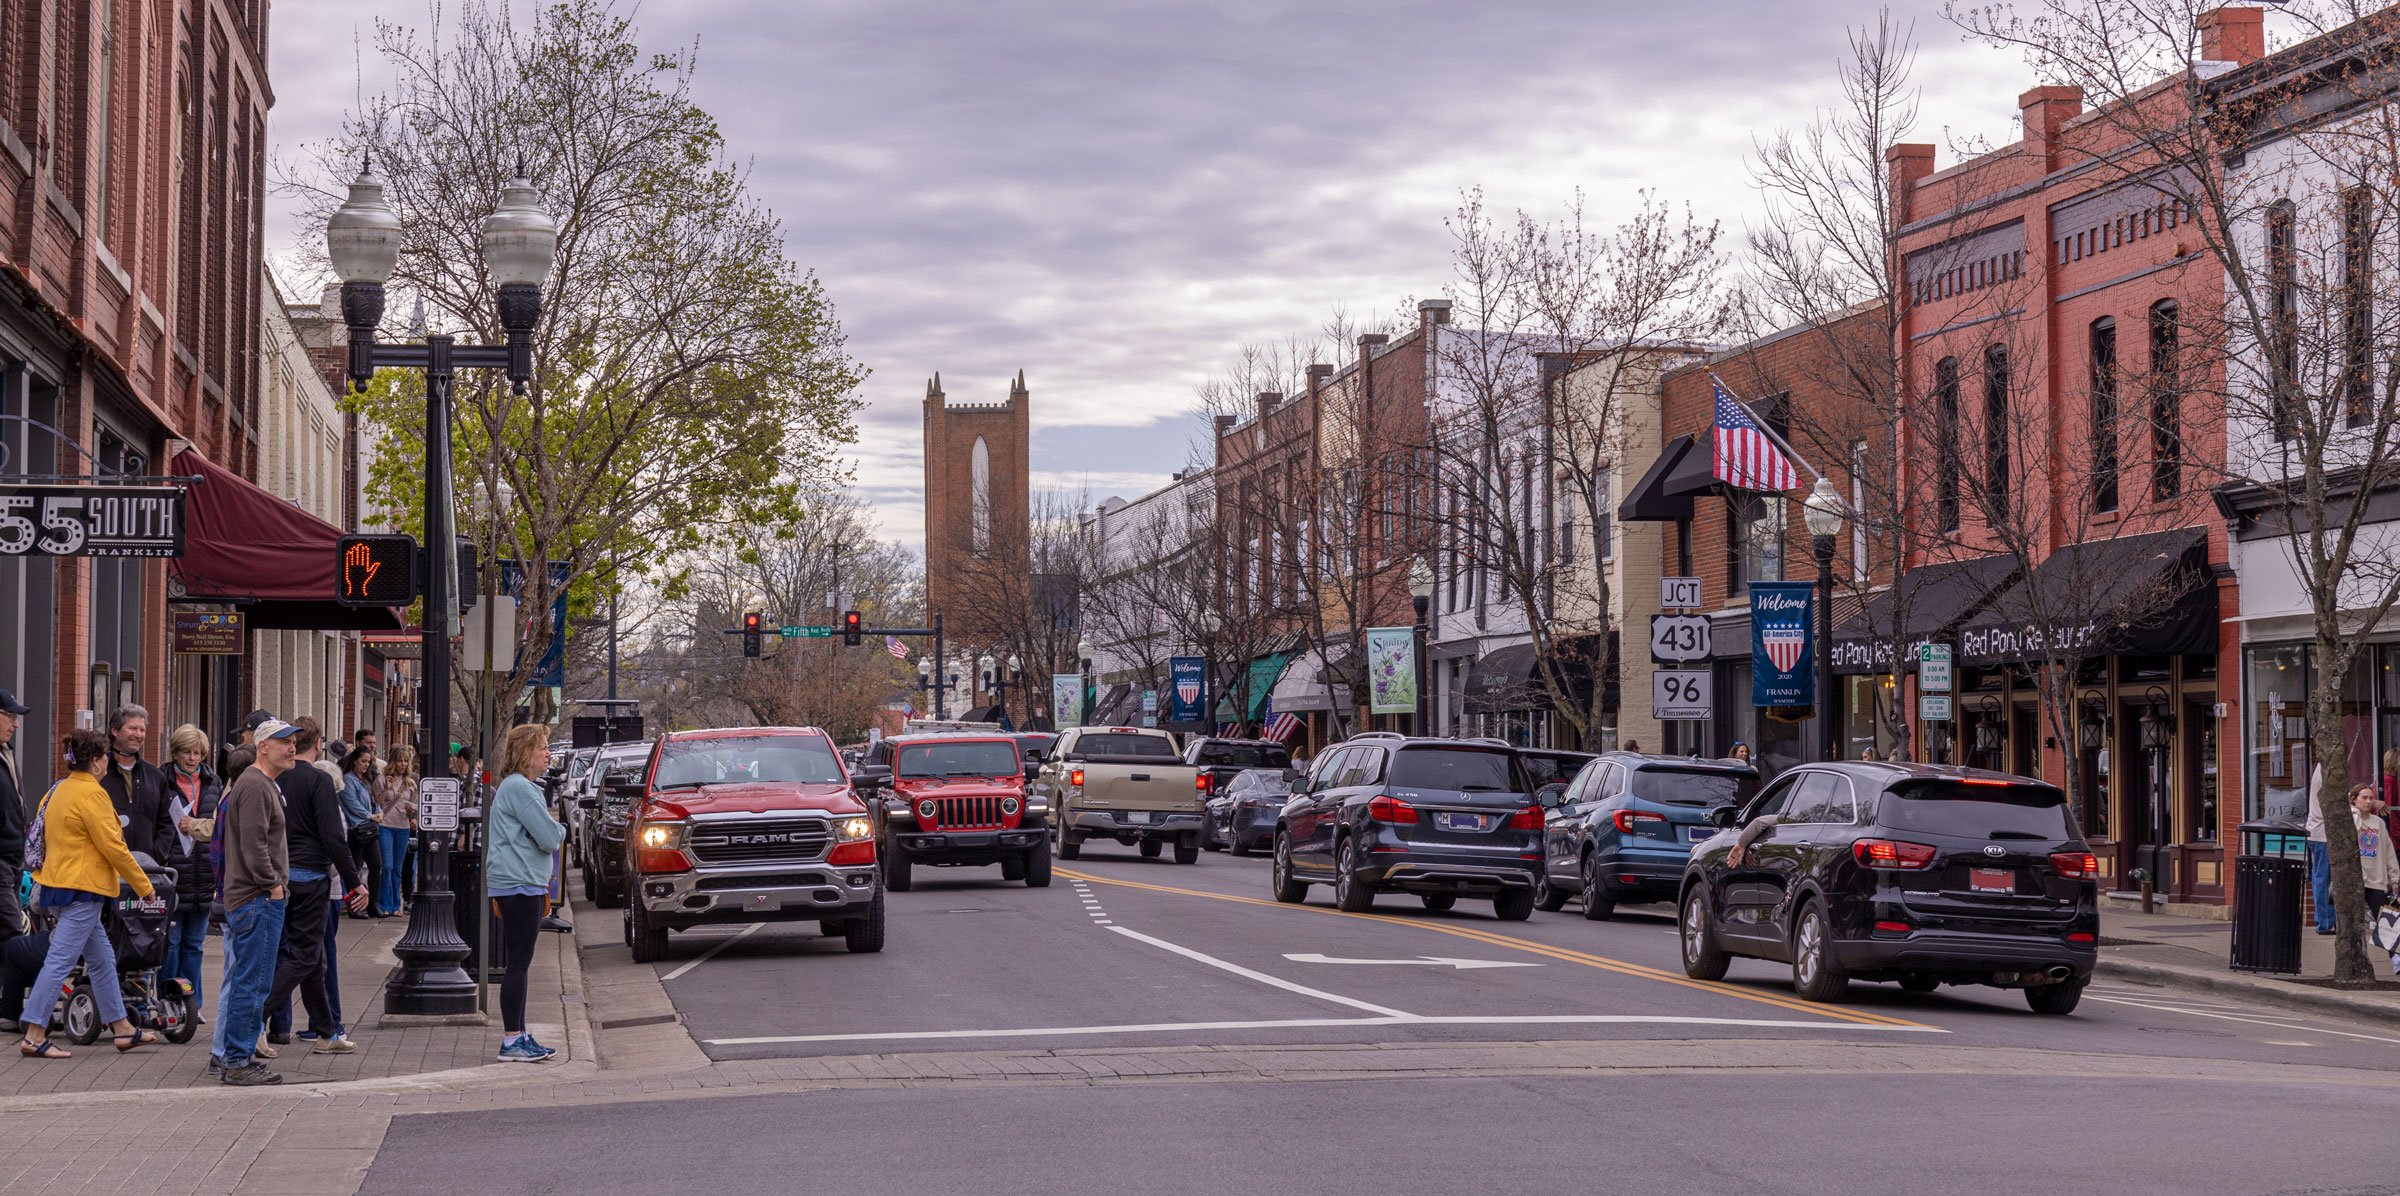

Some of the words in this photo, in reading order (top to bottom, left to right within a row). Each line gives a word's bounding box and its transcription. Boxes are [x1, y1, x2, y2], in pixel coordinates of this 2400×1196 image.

[0, 496, 85, 554] 55
[88, 497, 174, 537] SOUTH
[88, 548, 174, 556] FRANKLIN
[1665, 583, 1698, 603] JCT
[1758, 593, 1808, 611] Welcome
[793, 627, 810, 637] Fifth
[1659, 625, 1704, 651] 431
[1373, 637, 1409, 653] Spring
[1964, 629, 1988, 657] Red
[1991, 629, 2022, 657] Pony
[1831, 642, 1844, 666] ed
[1845, 641, 1872, 669] Pony
[1922, 648, 1931, 660] 2
[1174, 663, 1202, 672] Welcome
[1664, 677, 1700, 702] 96
[1766, 688, 1801, 696] FRANKLIN
[731, 833, 788, 844] RAM
